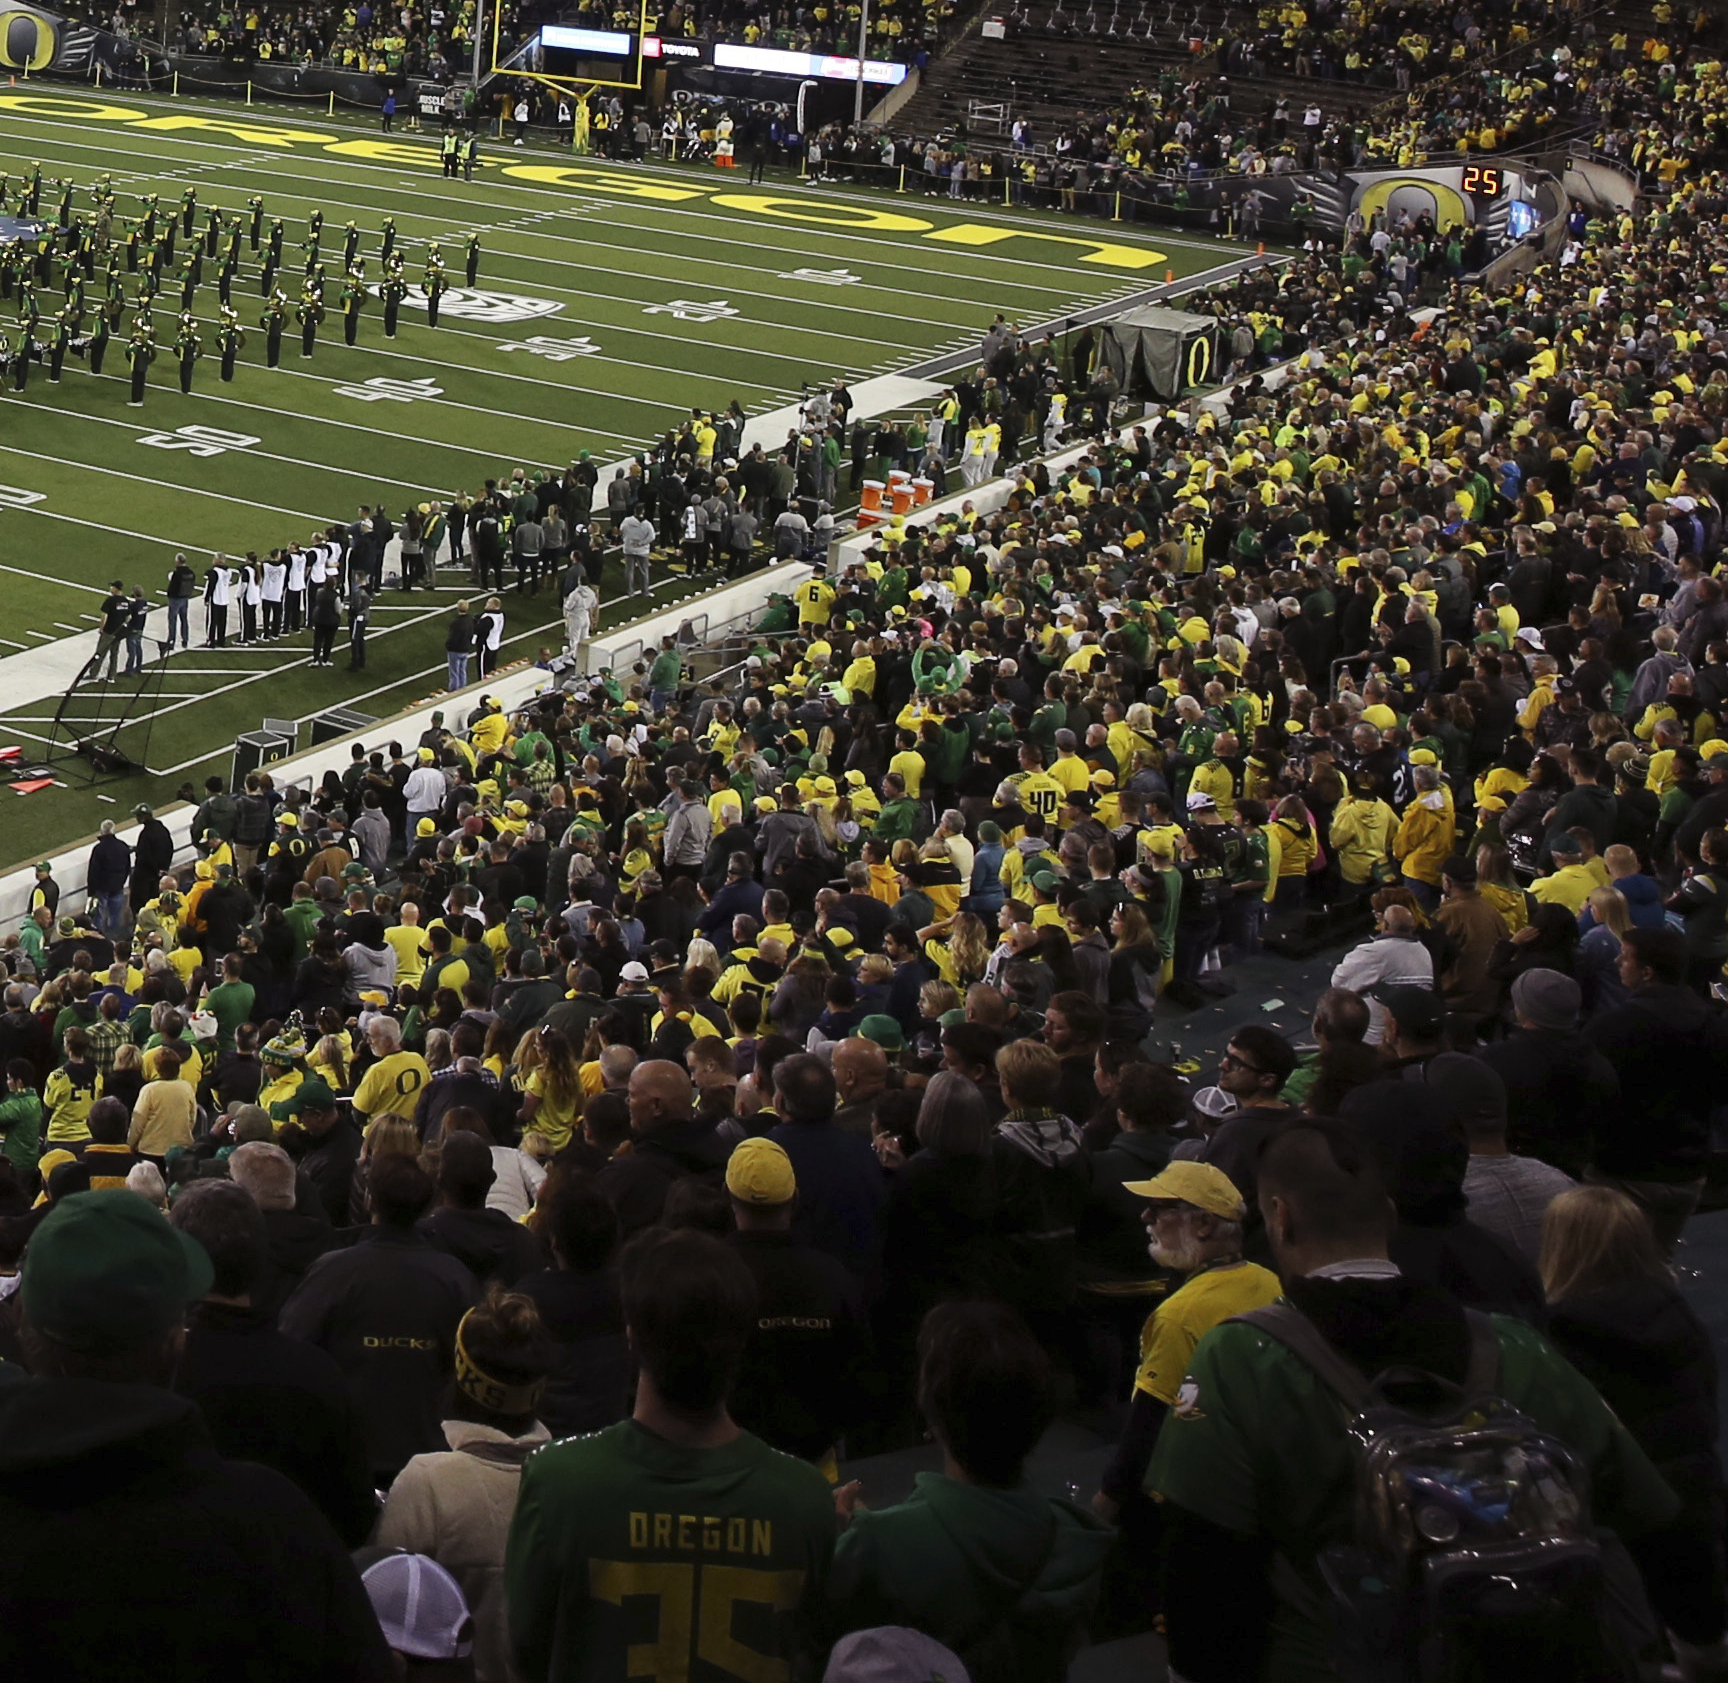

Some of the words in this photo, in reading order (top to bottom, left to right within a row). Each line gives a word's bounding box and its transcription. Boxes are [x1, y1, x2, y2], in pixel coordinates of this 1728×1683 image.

[661, 43, 701, 58] TOYOTA
[421, 104, 440, 115] MILK
[1464, 167, 1498, 195] 25
[136, 425, 262, 457] 50
[808, 586, 819, 602] 6
[1030, 791, 1056, 814] 40
[288, 838, 306, 857] O
[395, 1068, 421, 1095] O
[363, 1336, 437, 1352] DUCKS
[629, 1511, 772, 1557] OREGON
